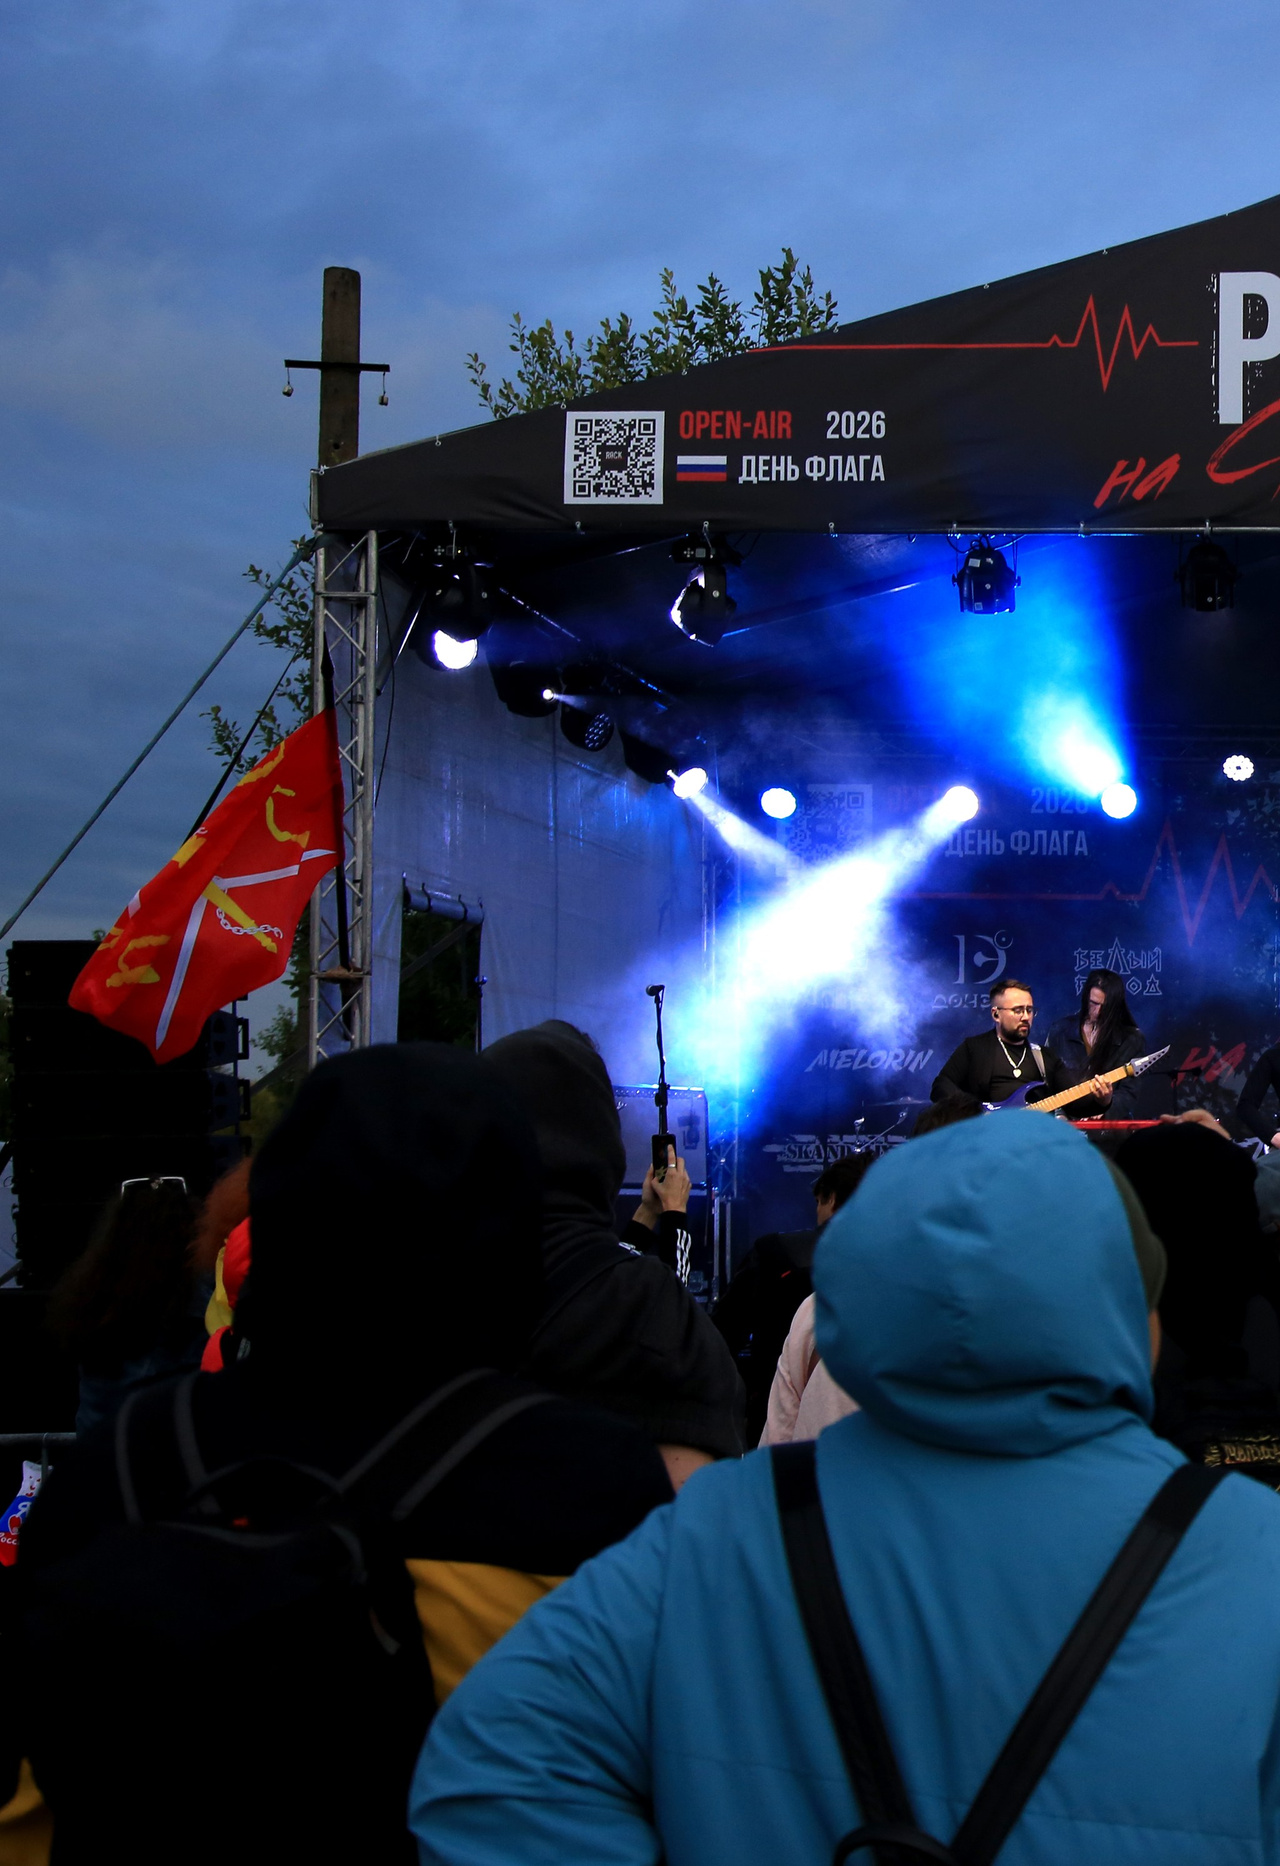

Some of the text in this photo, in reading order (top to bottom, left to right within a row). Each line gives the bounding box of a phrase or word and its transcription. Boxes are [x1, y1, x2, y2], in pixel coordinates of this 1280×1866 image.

[678, 410, 887, 440] OPEN-AIR 2026
[738, 454, 887, 484] ДЕНЬ ФЛАГА
[944, 829, 1089, 857] ДЕНЬ ФЛАГА
[803, 1048, 934, 1073] MELORIN
